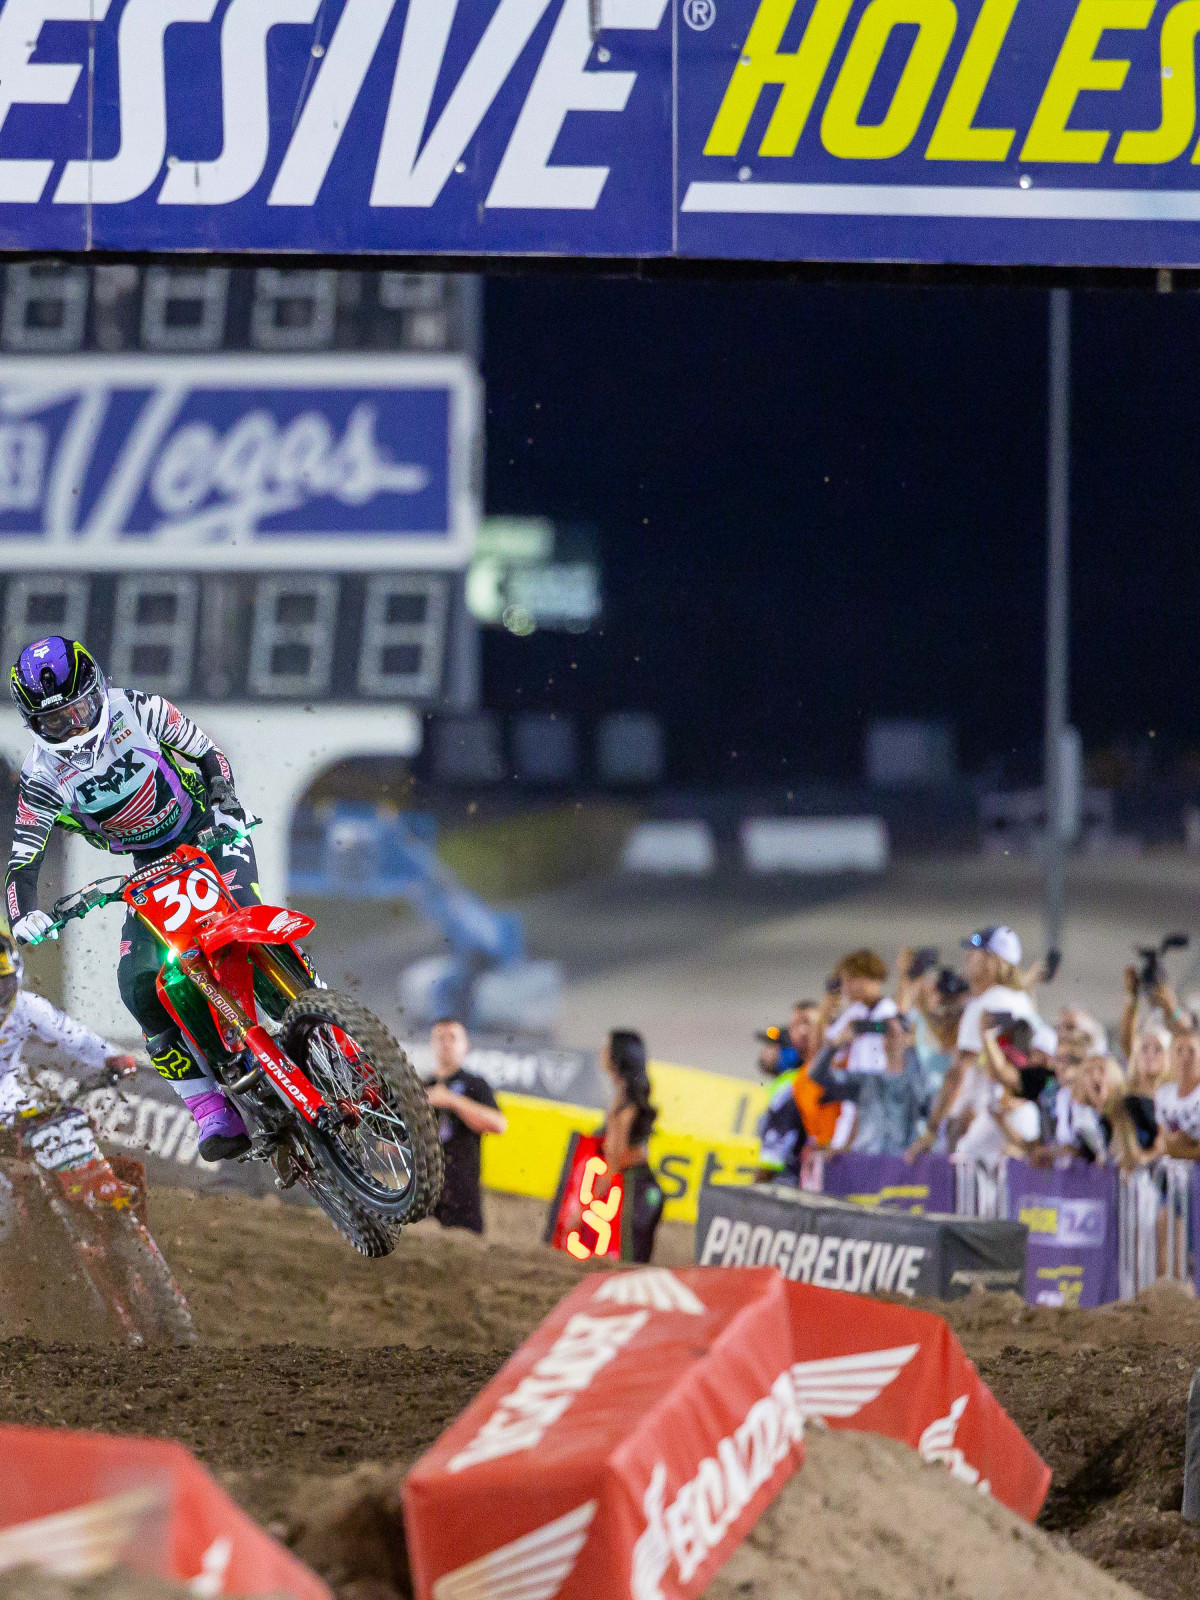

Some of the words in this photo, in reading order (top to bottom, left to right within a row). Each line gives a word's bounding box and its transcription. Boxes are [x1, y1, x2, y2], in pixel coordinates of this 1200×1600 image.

[702, 0, 1200, 164] HOLES
[107, 797, 179, 839] HONDA
[152, 867, 220, 932] 30
[202, 984, 239, 1023] SHOWA
[258, 1051, 309, 1105] DUNLOP
[701, 1216, 926, 1297] PROGRESSIVE
